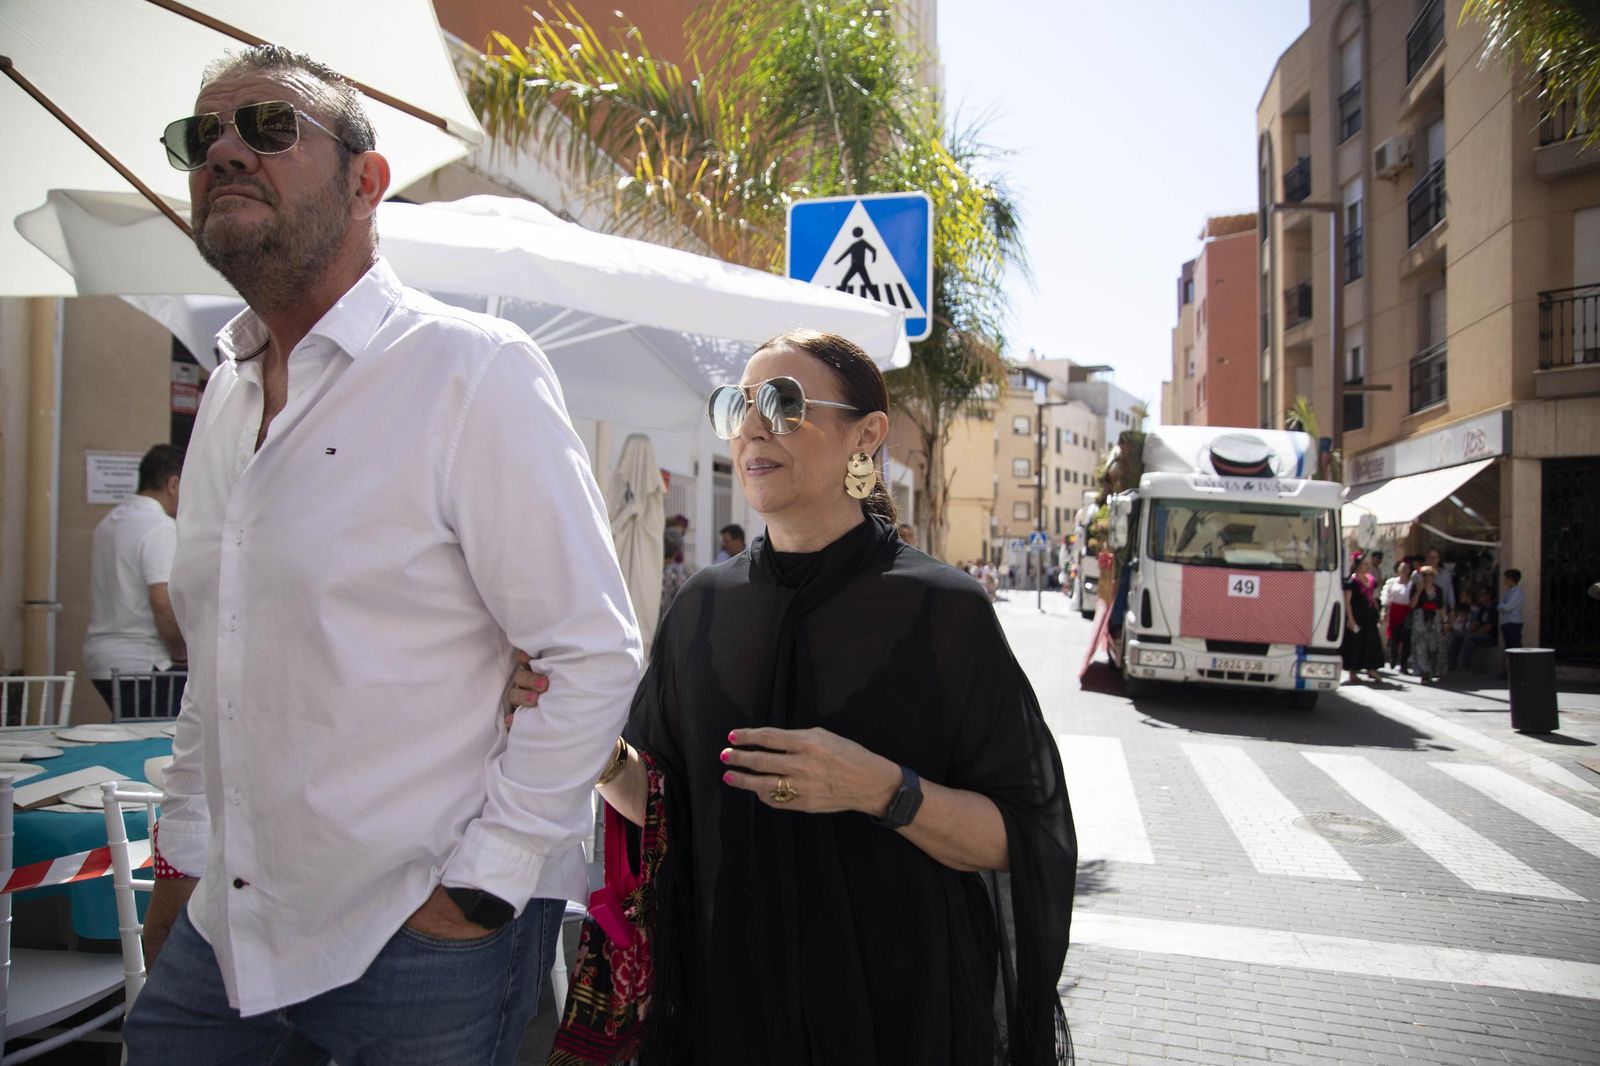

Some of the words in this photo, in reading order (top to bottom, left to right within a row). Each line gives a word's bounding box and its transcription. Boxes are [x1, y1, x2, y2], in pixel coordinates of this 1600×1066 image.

[1243, 481, 1254, 490] &
[1232, 578, 1255, 595] 49
[1217, 658, 1242, 669] 2824
